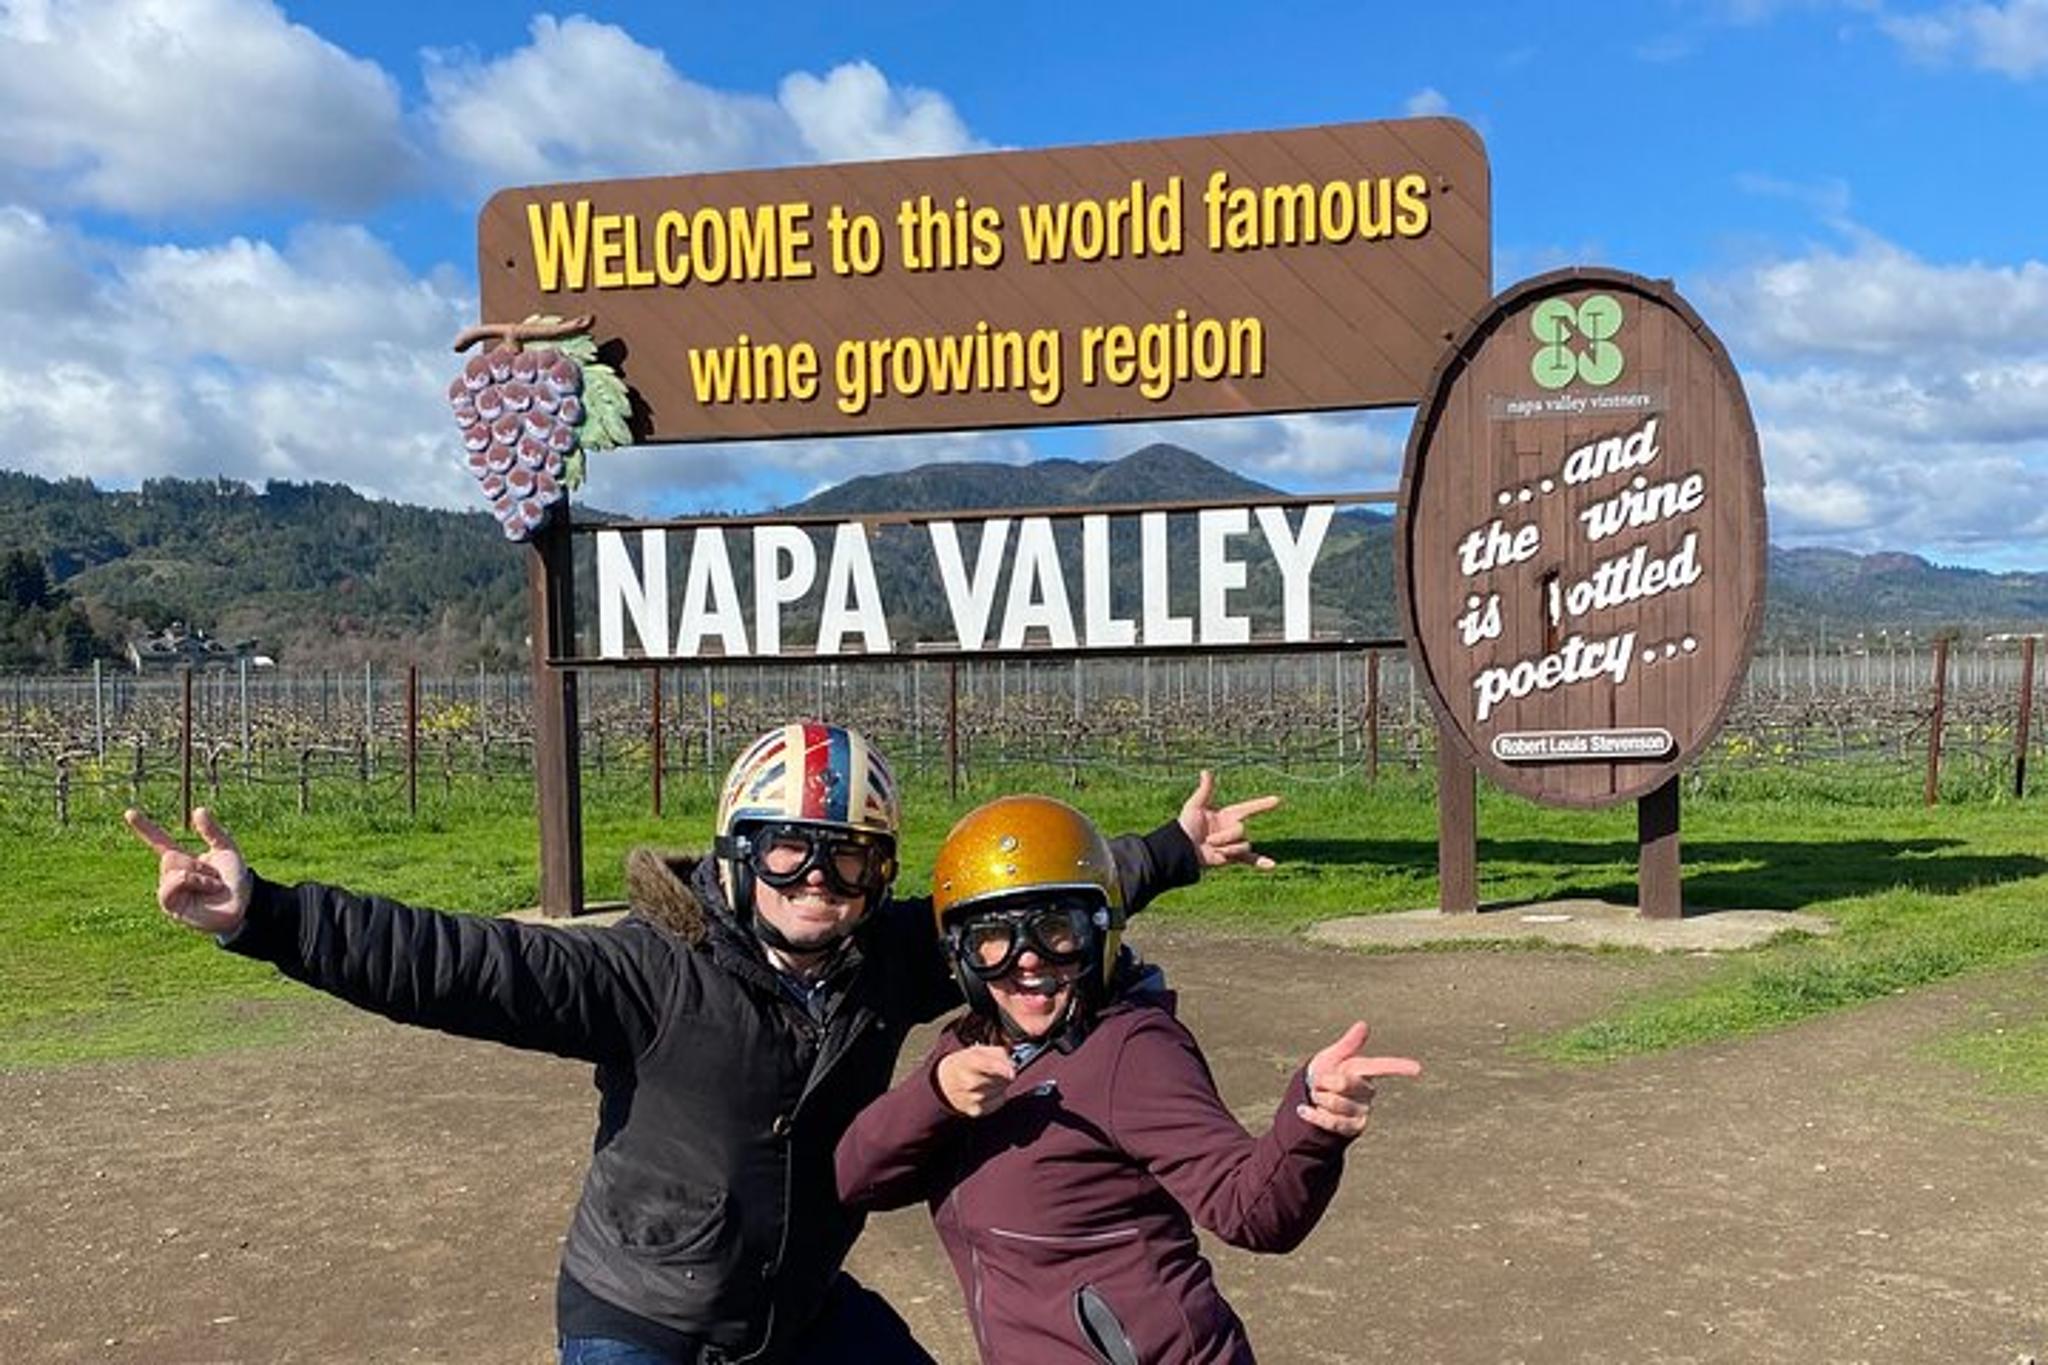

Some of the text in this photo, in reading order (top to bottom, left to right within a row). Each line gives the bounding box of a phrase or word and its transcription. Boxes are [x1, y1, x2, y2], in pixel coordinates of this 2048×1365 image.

[527, 171, 1428, 291] WELCOME to this world famous
[689, 309, 1262, 413] wine growing region
[1507, 400, 1543, 415] napa
[1546, 395, 1588, 413] valley
[1458, 474, 1704, 576] the wine
[597, 505, 1334, 659] NAPA VALLEY
[1458, 594, 1501, 646] is
[1500, 735, 1665, 755] Robert Louis Stevenson
